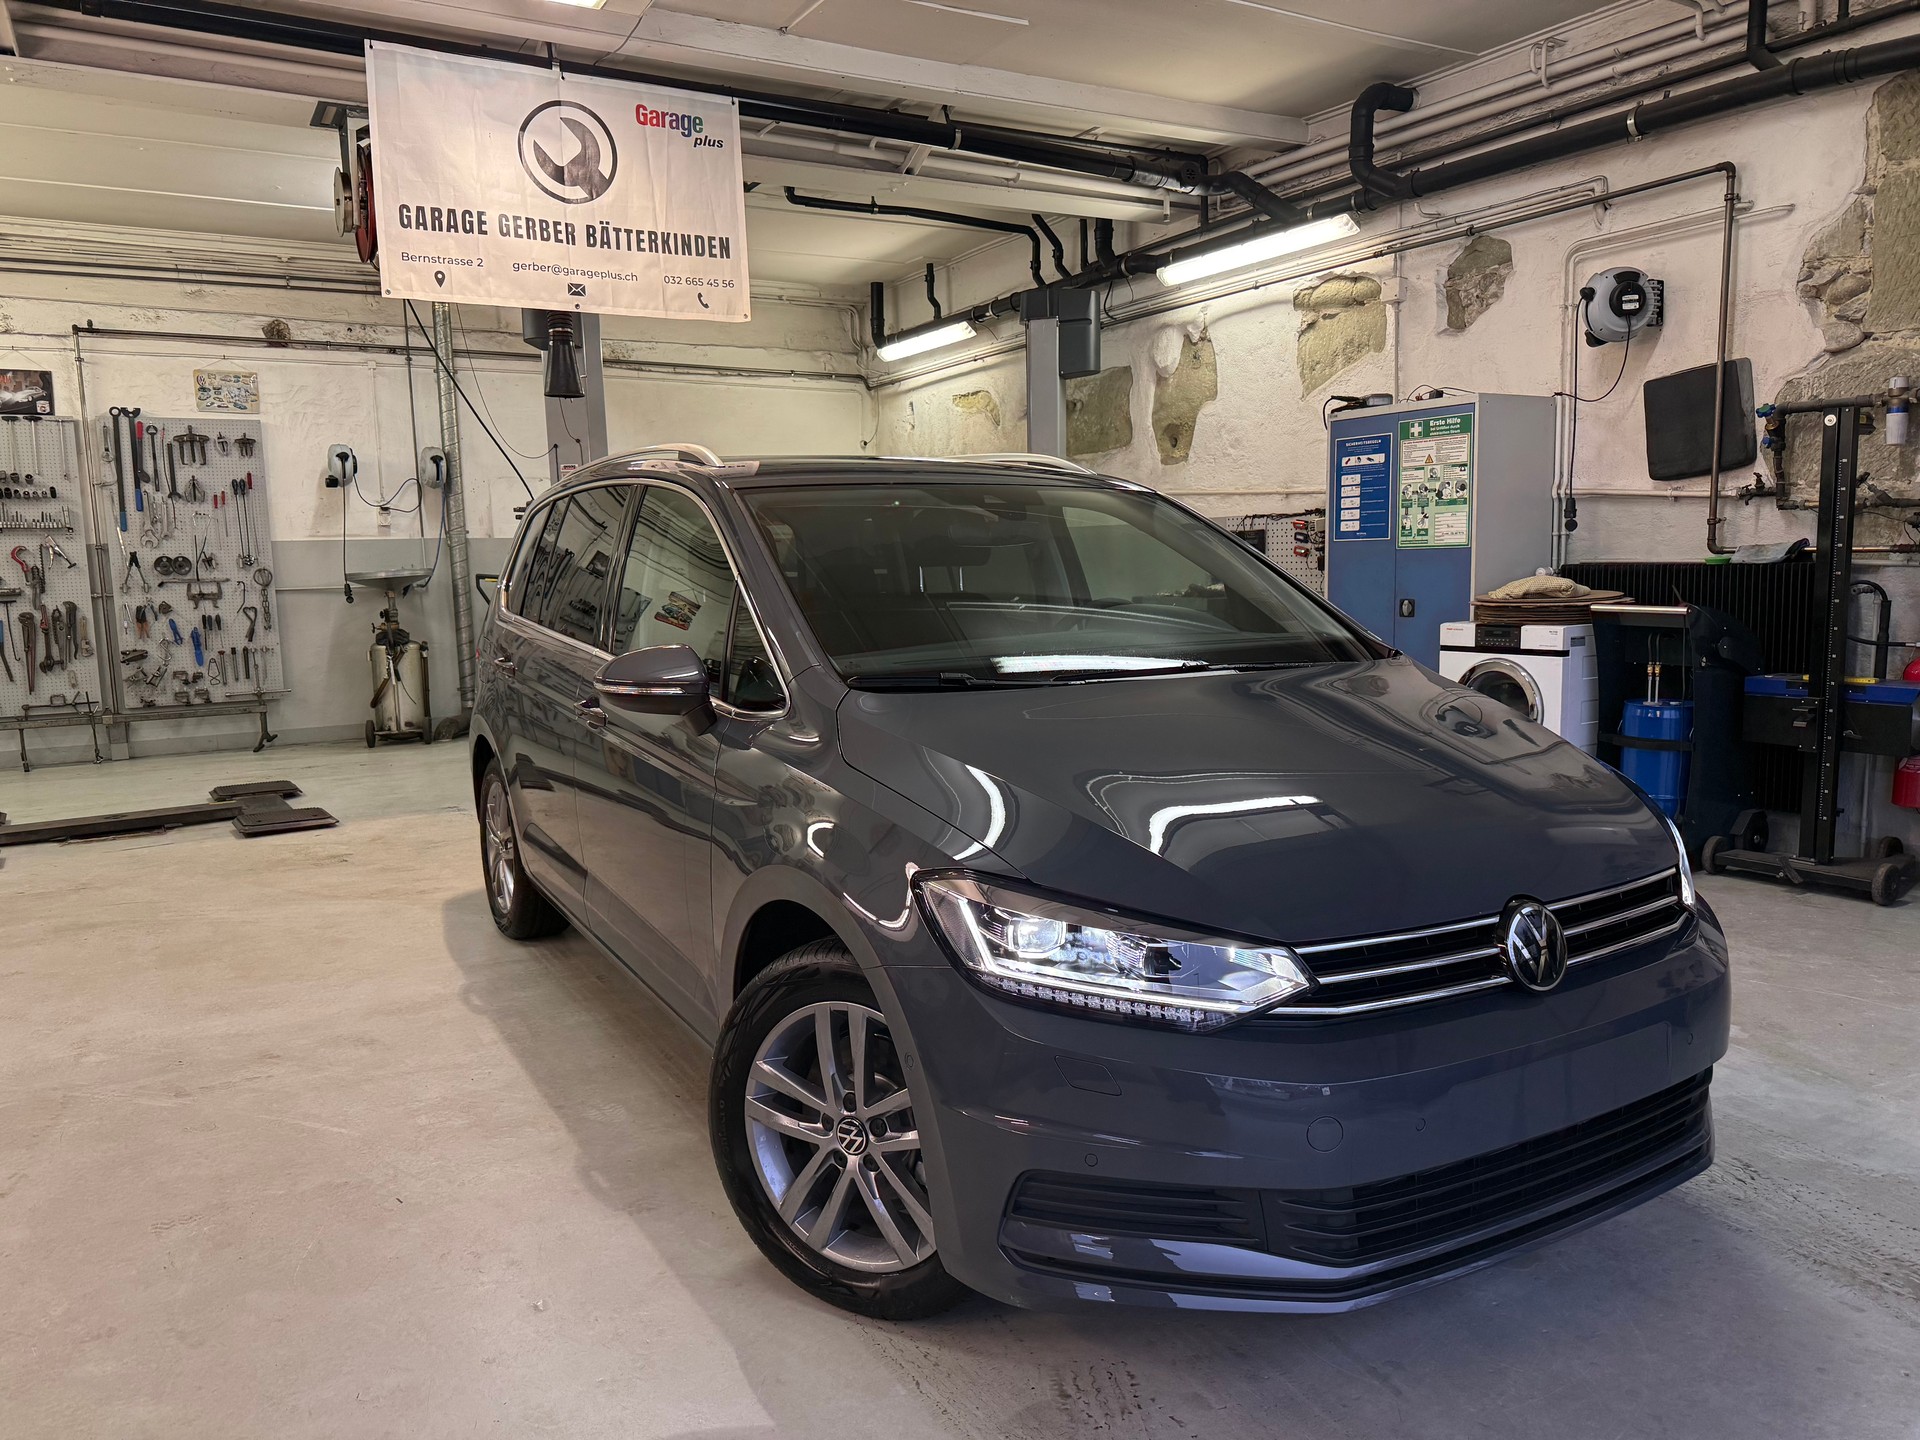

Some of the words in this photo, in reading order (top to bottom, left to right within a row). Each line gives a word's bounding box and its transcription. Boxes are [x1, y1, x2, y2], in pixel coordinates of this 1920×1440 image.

[635, 103, 704, 138] Garage
[693, 135, 724, 148] plus
[398, 203, 489, 236] GARAGE
[498, 213, 577, 246] GERBER
[585, 220, 731, 260] BÄTTERKINDEN
[401, 252, 473, 267] Bernstrasse
[477, 258, 484, 268] 2
[512, 261, 638, 283] gerber@garageplus.ch
[663, 275, 683, 285] 032
[686, 276, 704, 287] 665
[707, 279, 719, 288] 45
[722, 279, 735, 289] 56
